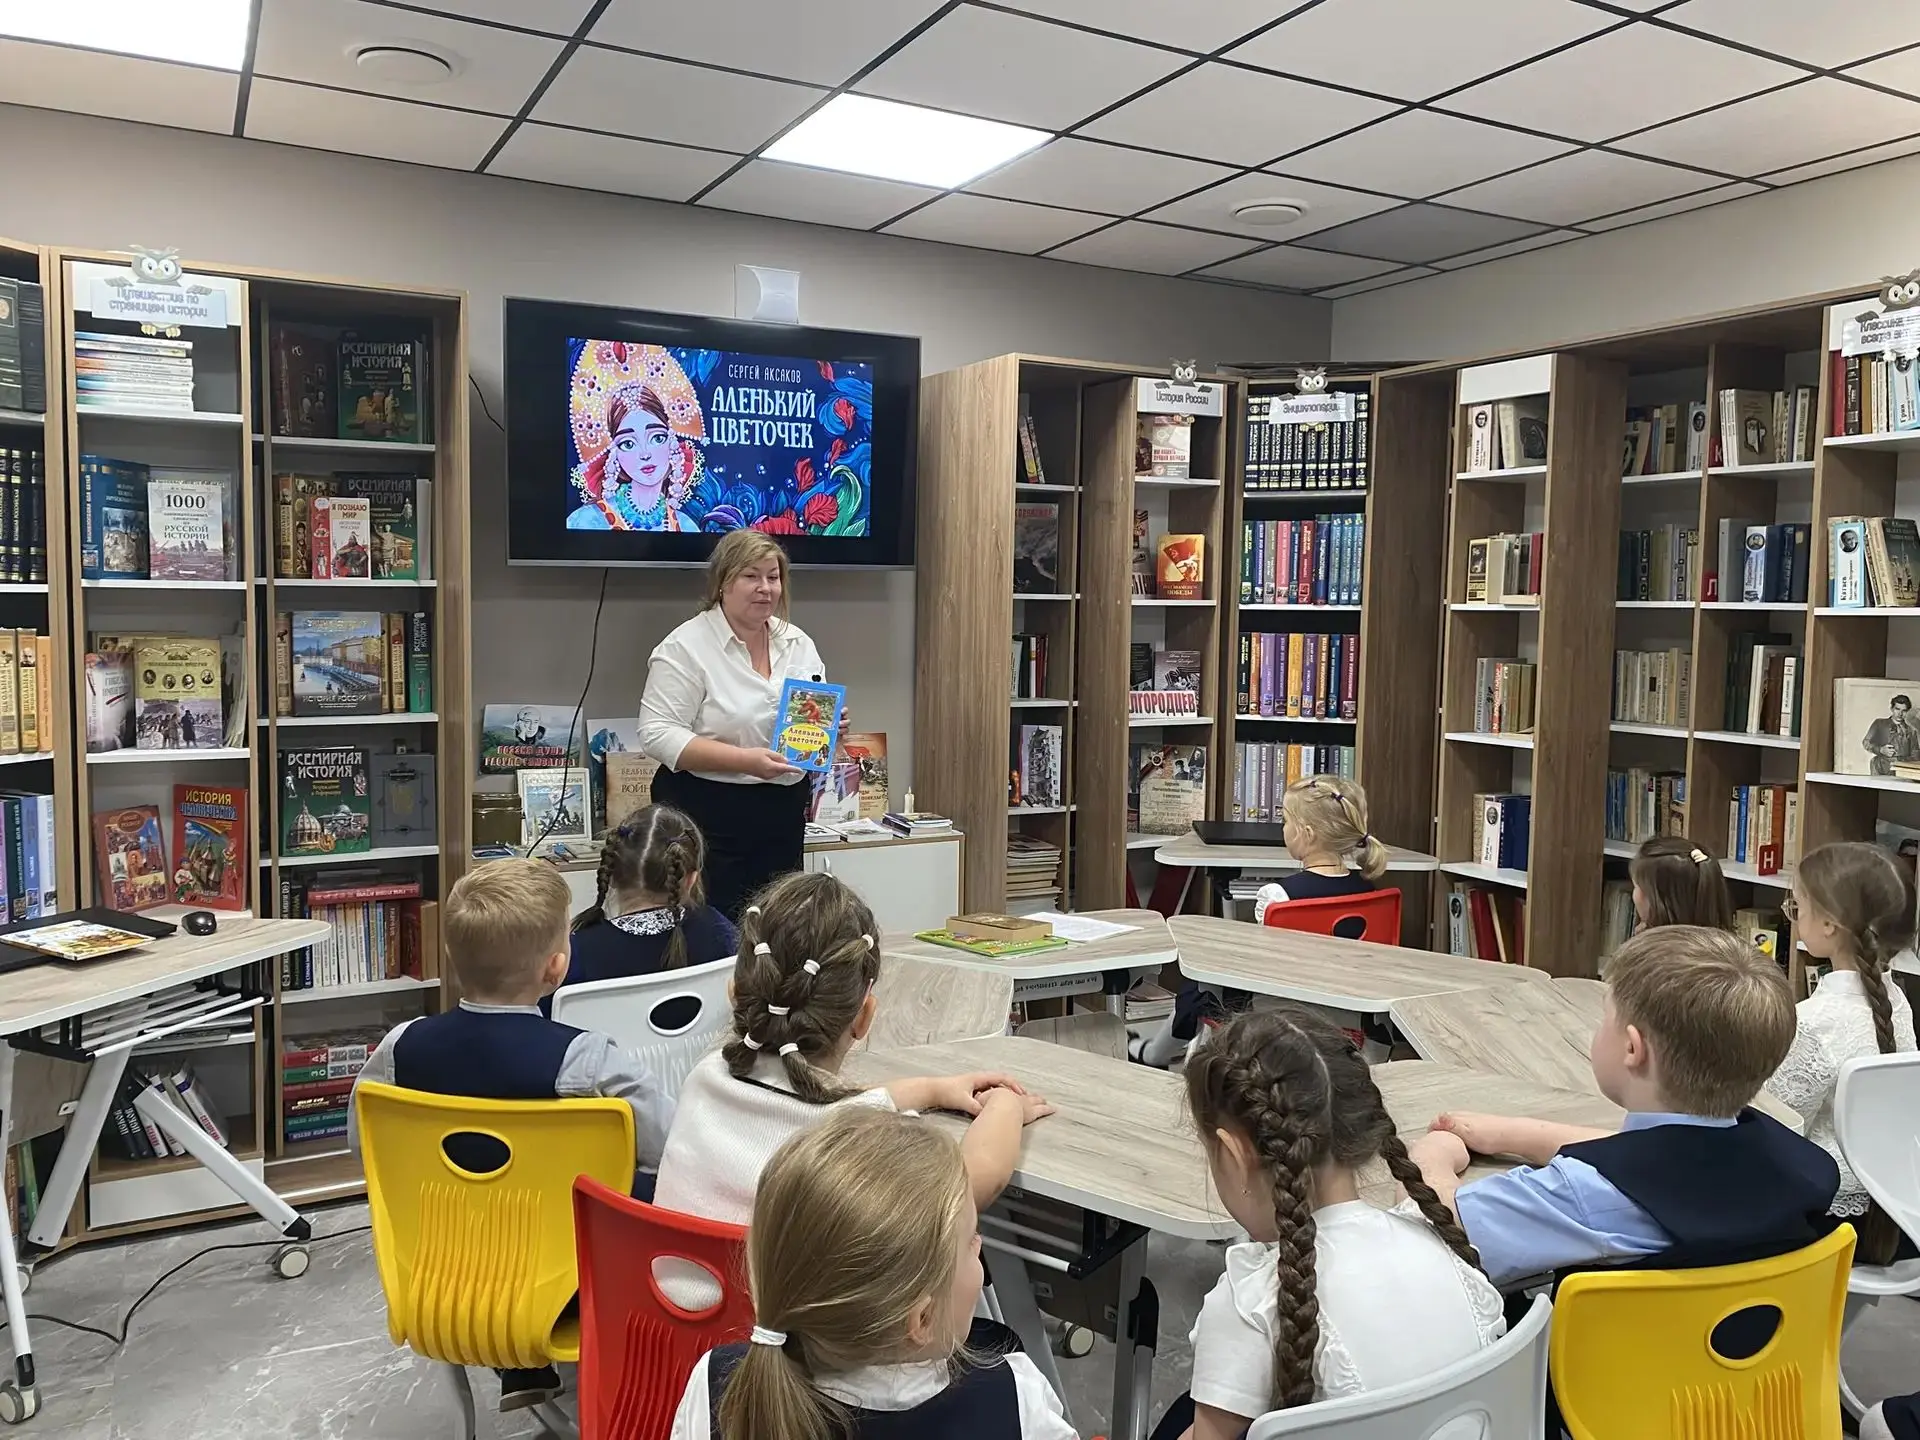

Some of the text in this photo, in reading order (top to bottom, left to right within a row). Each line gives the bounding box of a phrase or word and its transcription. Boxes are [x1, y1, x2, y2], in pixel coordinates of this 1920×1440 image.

[342, 342, 411, 356] ВСЕМИРНАЯ
[352, 356, 402, 368] ИСТОРИЯ
[728, 364, 802, 384] СЕРГЕЙ АКСАКОВ
[710, 384, 817, 419] АЛЕНЬКИЙ
[1156, 390, 1209, 405] История России
[712, 418, 814, 449] ЦВЕТОЧЕК
[349, 479, 411, 491] ВСЕМИРНАЯ
[166, 494, 206, 509] 1000
[342, 511, 357, 519] МИР
[164, 524, 208, 534] РУССКОЙ
[164, 532, 209, 540] ИСТОРИИ
[788, 727, 825, 738] Аленький
[787, 736, 822, 746] цветочек
[288, 752, 362, 766] ВСЕМИРНАЯ
[297, 765, 353, 779] ИСТОРИЯ
[621, 782, 650, 793] ВОЙН
[185, 790, 232, 805] ИСТОРИЯ
[1764, 851, 1774, 869] Н
